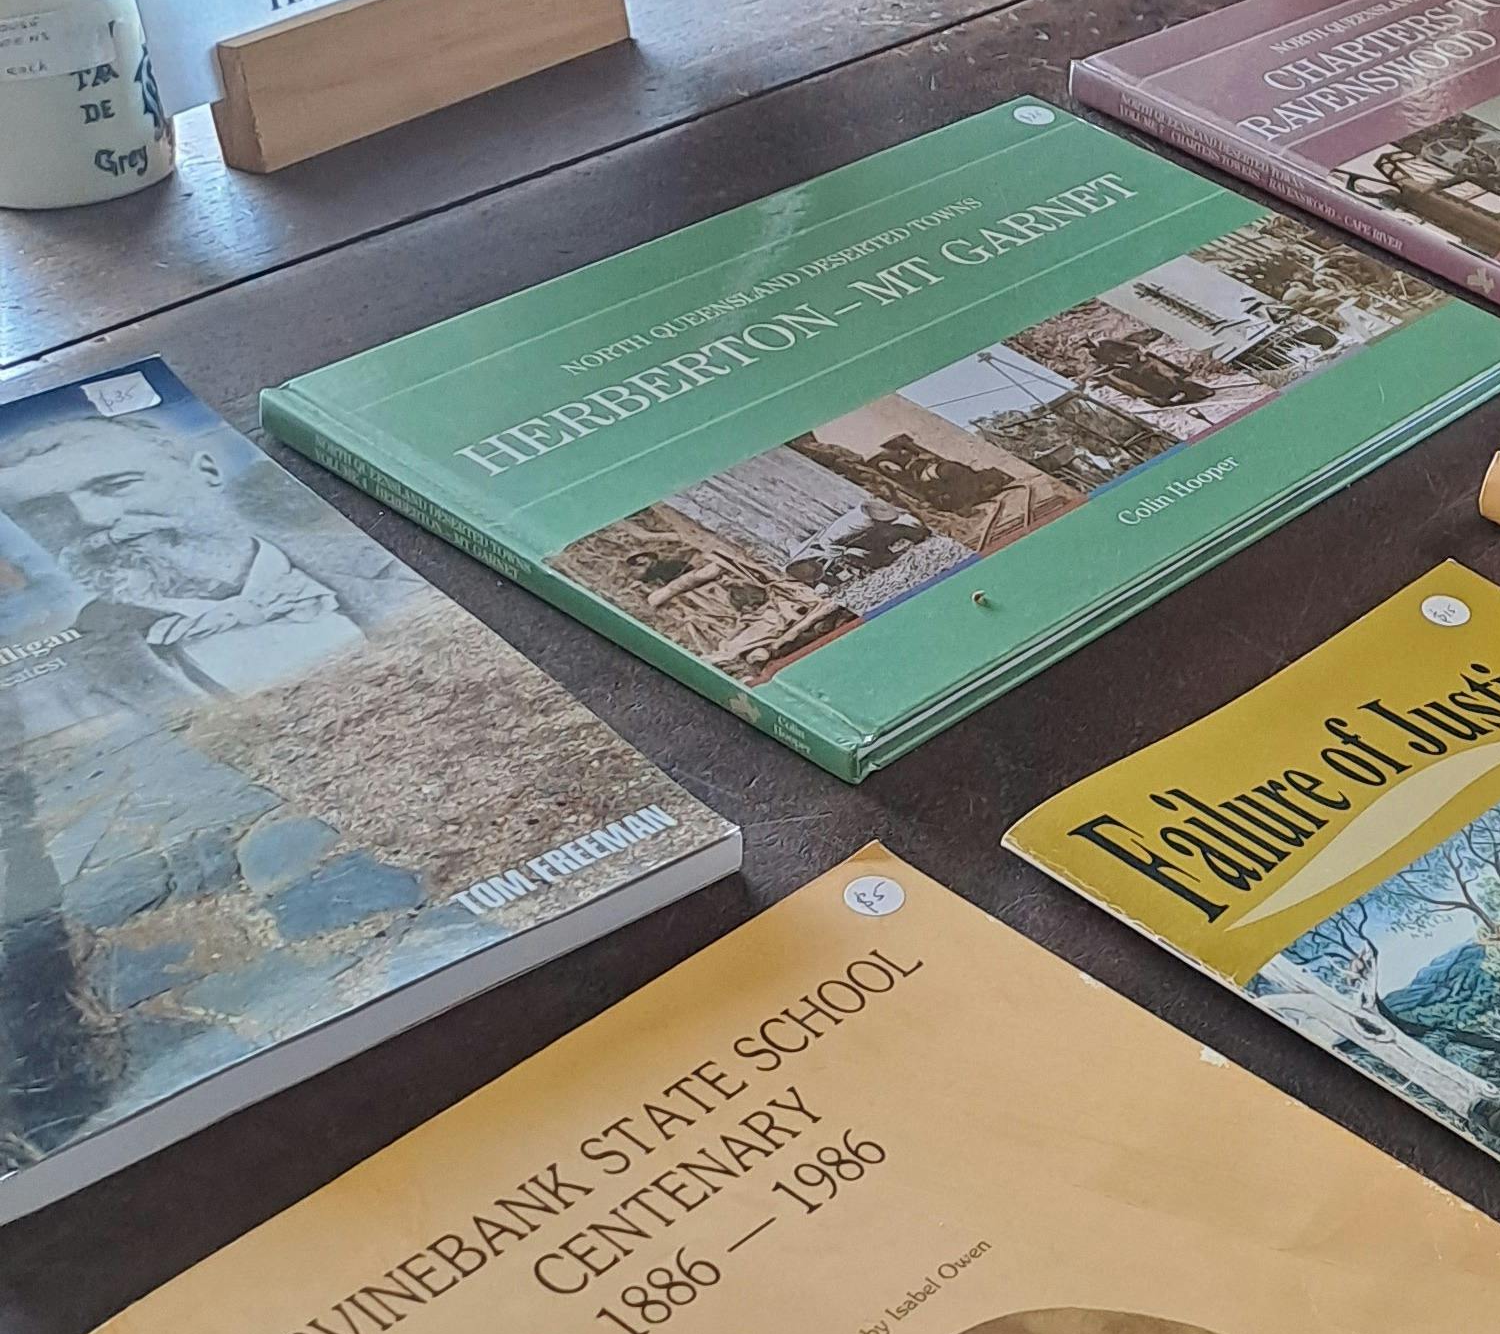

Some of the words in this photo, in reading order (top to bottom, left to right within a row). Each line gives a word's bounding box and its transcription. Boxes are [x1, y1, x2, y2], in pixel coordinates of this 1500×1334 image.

[1237, 28, 1497, 143] RAVENSWOOD
[1263, 3, 1465, 93] CHARTERS
[1270, 28, 1327, 55] NORTH
[80, 100, 116, 124] DE
[94, 136, 148, 176] Grey
[453, 301, 839, 478] HERBERTON
[848, 255, 946, 307] MT
[940, 172, 1139, 266] GARNET
[560, 330, 653, 377] NORTH
[649, 269, 803, 340] QUEENSLAND
[799, 225, 913, 280] DESERTED
[906, 197, 985, 234] TOWNS
[1118, 495, 1175, 525] Colin
[1165, 456, 1239, 498] Hooper
[450, 868, 538, 916] TOM
[526, 804, 679, 884] FREEMAN
[1068, 788, 1352, 925] Failure
[1319, 716, 1414, 788] of
[853, 880, 886, 915] $5
[579, 1059, 749, 1175] STATE
[732, 948, 924, 1074] SCHOOL
[532, 1085, 823, 1296] CENTENARY
[771, 1127, 889, 1216] 1986
[884, 1276, 942, 1322] Isabel
[937, 1240, 993, 1280] Owen
